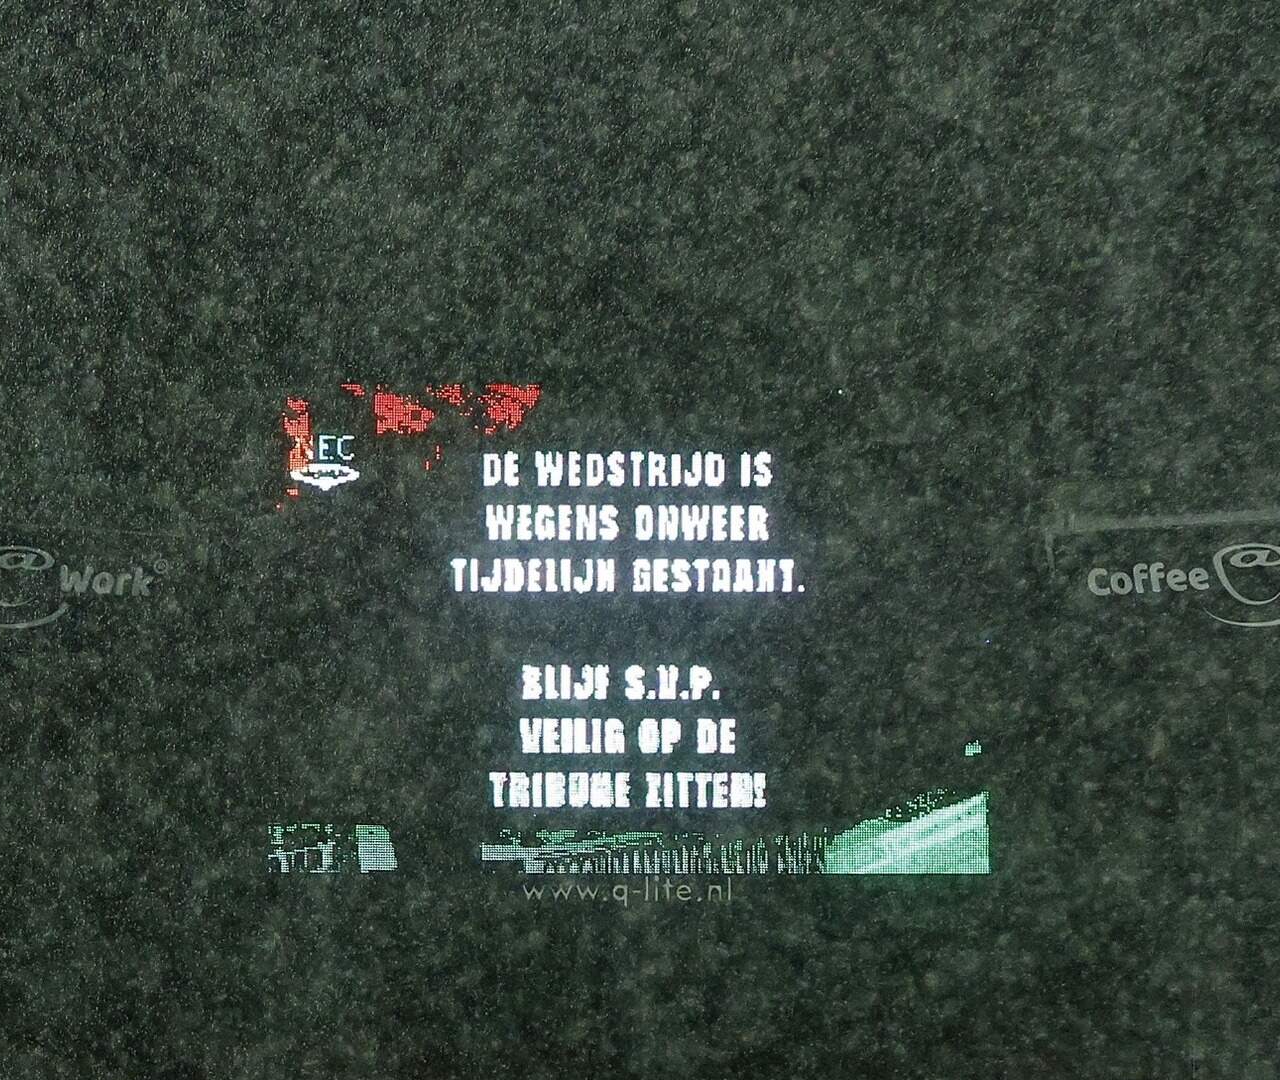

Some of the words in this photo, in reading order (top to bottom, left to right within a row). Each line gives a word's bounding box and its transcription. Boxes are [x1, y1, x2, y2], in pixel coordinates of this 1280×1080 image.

[483, 451, 519, 487] DE
[740, 451, 773, 487] IS
[485, 504, 619, 541] WEGENS
[634, 504, 769, 542] ONWEER
[1087, 561, 1210, 597] Coffee
[521, 664, 610, 700] BLIJF
[519, 717, 626, 754] VEILIG
[637, 717, 682, 754] OP
[696, 717, 736, 754] DE
[488, 771, 631, 808] TRIBUNE
[523, 876, 732, 907] www.q-lite.nl
